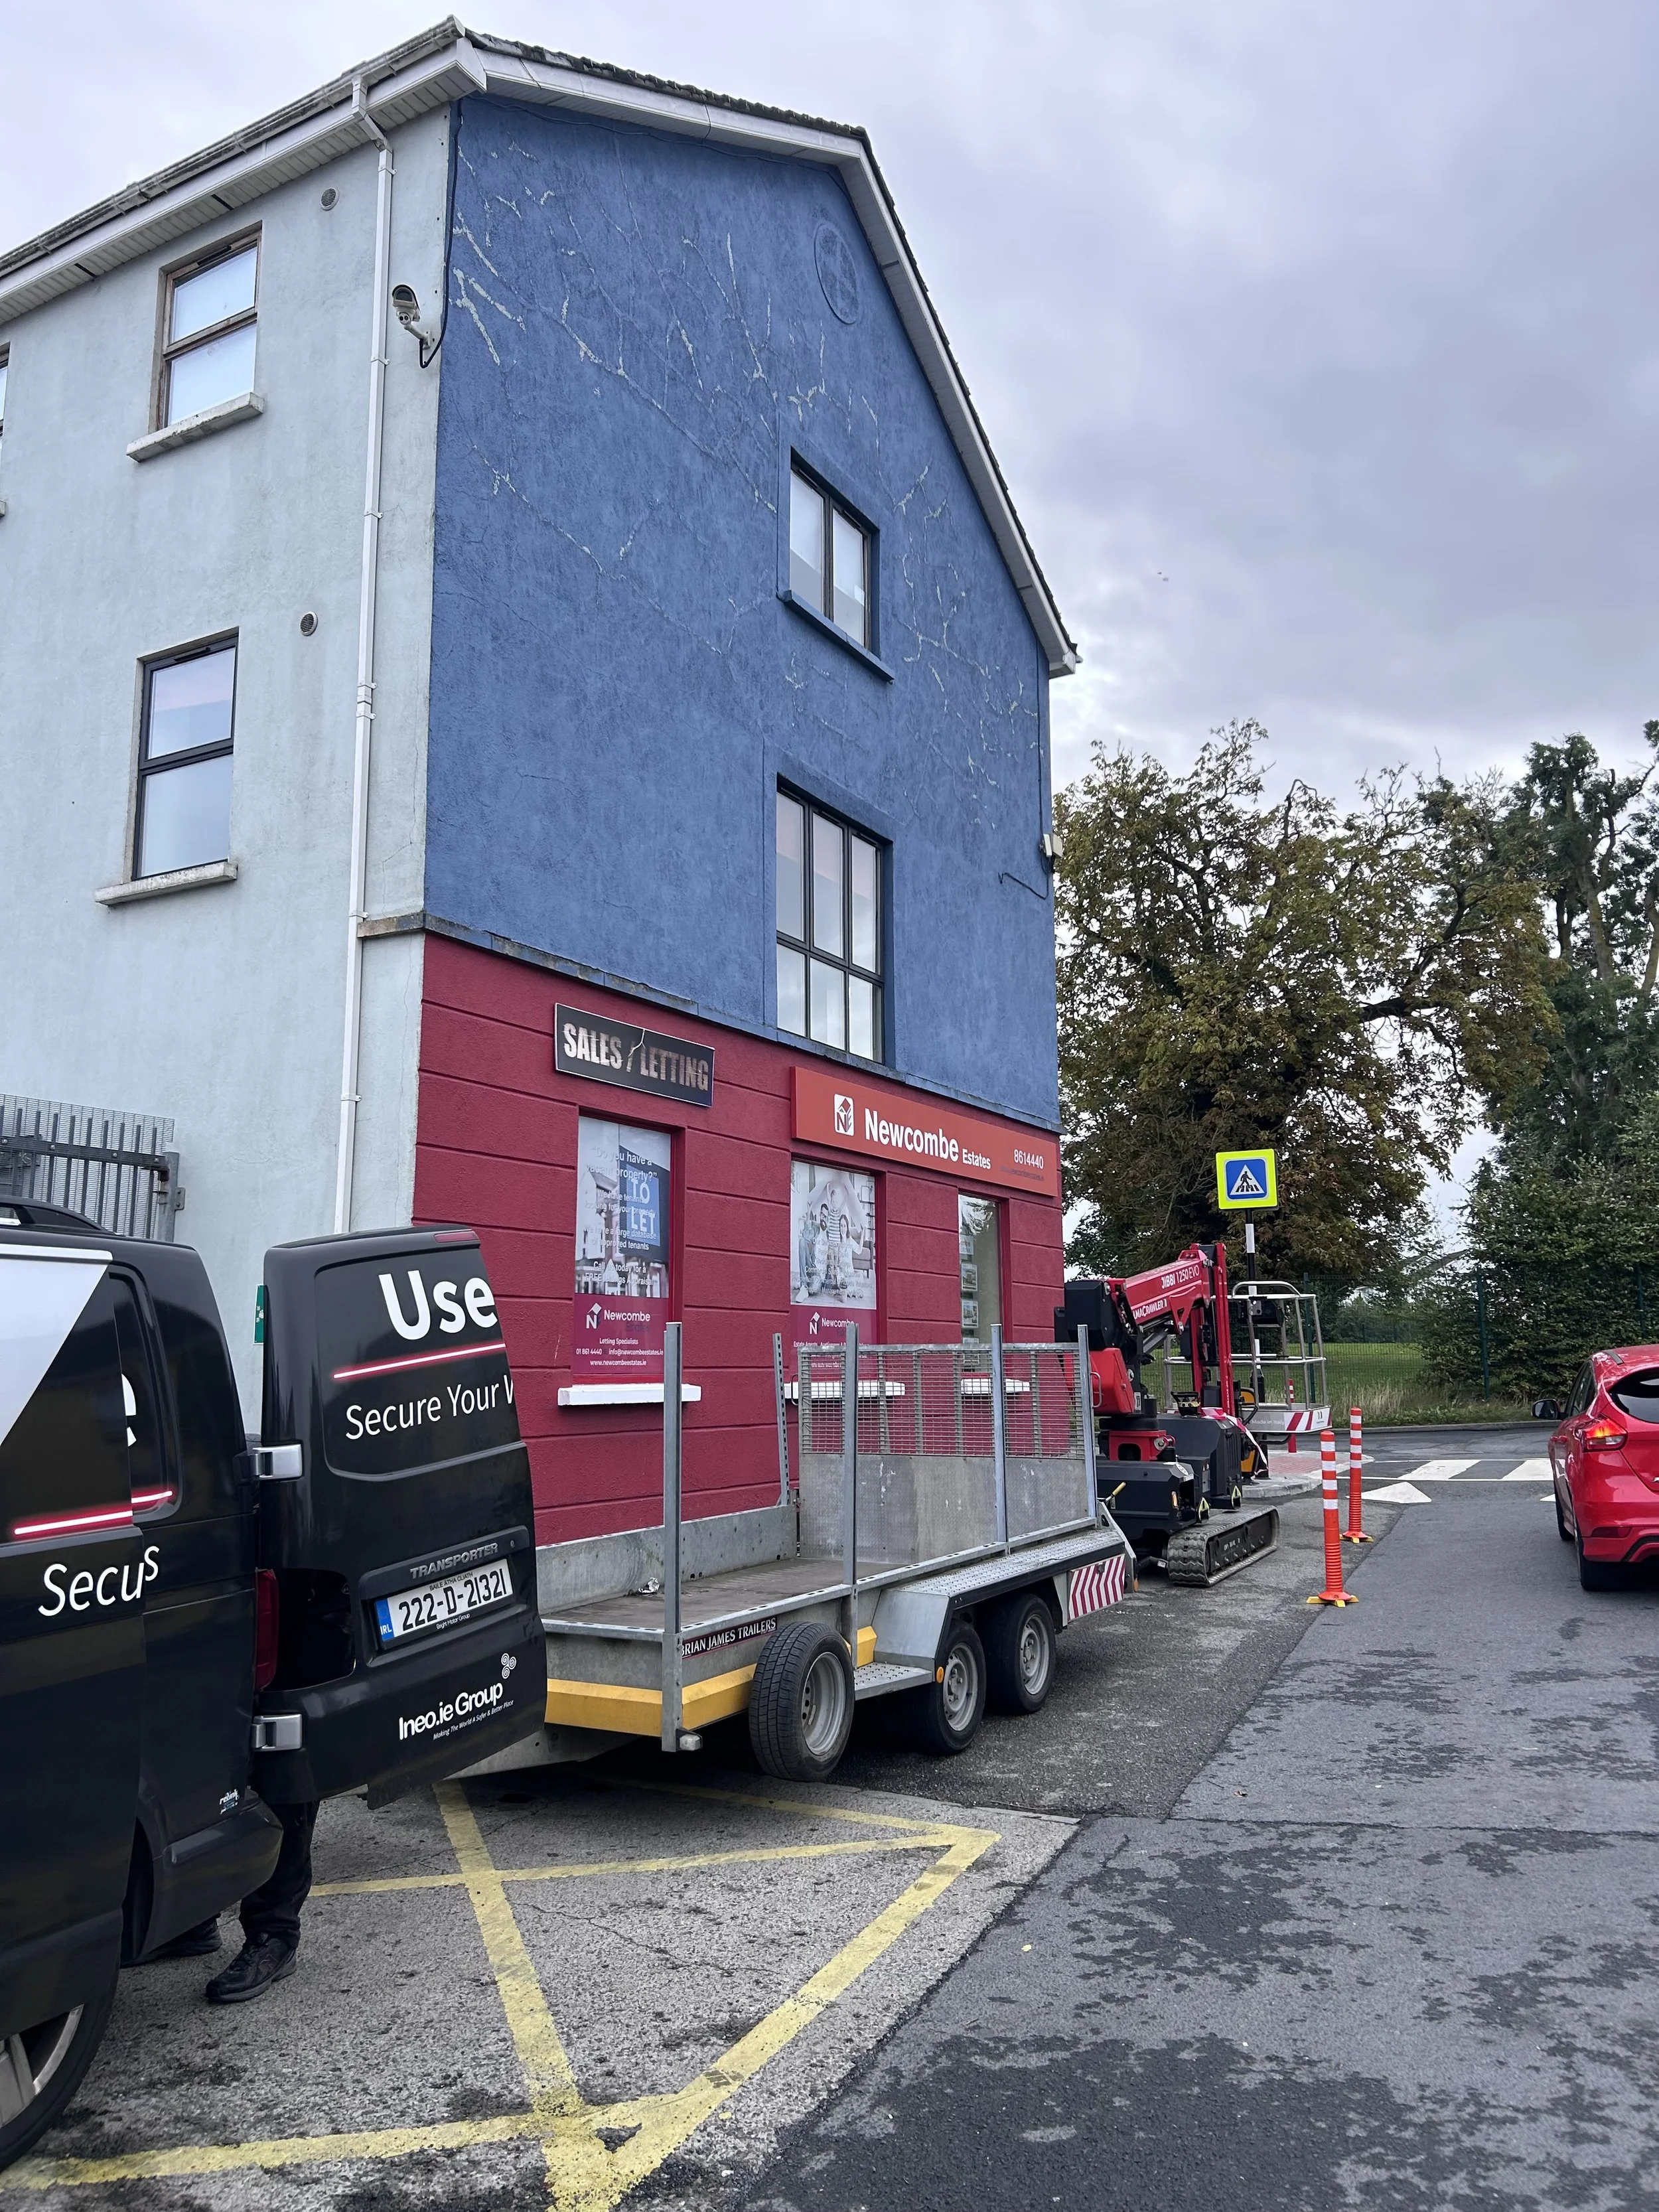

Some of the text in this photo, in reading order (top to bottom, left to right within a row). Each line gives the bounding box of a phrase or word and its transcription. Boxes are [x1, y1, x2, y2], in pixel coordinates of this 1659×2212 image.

[564, 1023, 622, 1069] SALES
[640, 1046, 708, 1091] LETTING
[865, 1108, 959, 1162] Newcombe
[962, 1148, 991, 1169] Estates
[627, 1151, 646, 1165] have
[1014, 1149, 1044, 1169] 8614440
[631, 1178, 650, 1204] TO
[631, 1206, 655, 1234] LET
[627, 1242, 650, 1250] tenants
[631, 1230, 657, 1240] database
[615, 1264, 631, 1274] today
[1161, 1264, 1200, 1290] JIBBI 1250 EVO
[378, 1270, 498, 1340] Use
[604, 1309, 650, 1322] Newcombe
[599, 1337, 615, 1346] Letting
[345, 1396, 441, 1440] Secure
[447, 1383, 499, 1417] Your
[410, 1542, 498, 1580] TRANSPORTER
[429, 1582, 443, 1591] BAILE
[457, 1572, 473, 1582] CLIATH
[399, 1568, 506, 1631] 222-D-21321
[380, 1624, 392, 1635] IRL
[707, 1630, 735, 1651] JAMES
[737, 1617, 776, 1639] TRAILERS
[399, 1682, 503, 1740] Ineo.ie Group
[433, 1728, 450, 1740] Making
[459, 1718, 472, 1729] World
[491, 1705, 503, 1715] Better
[503, 1700, 514, 1709] Place
